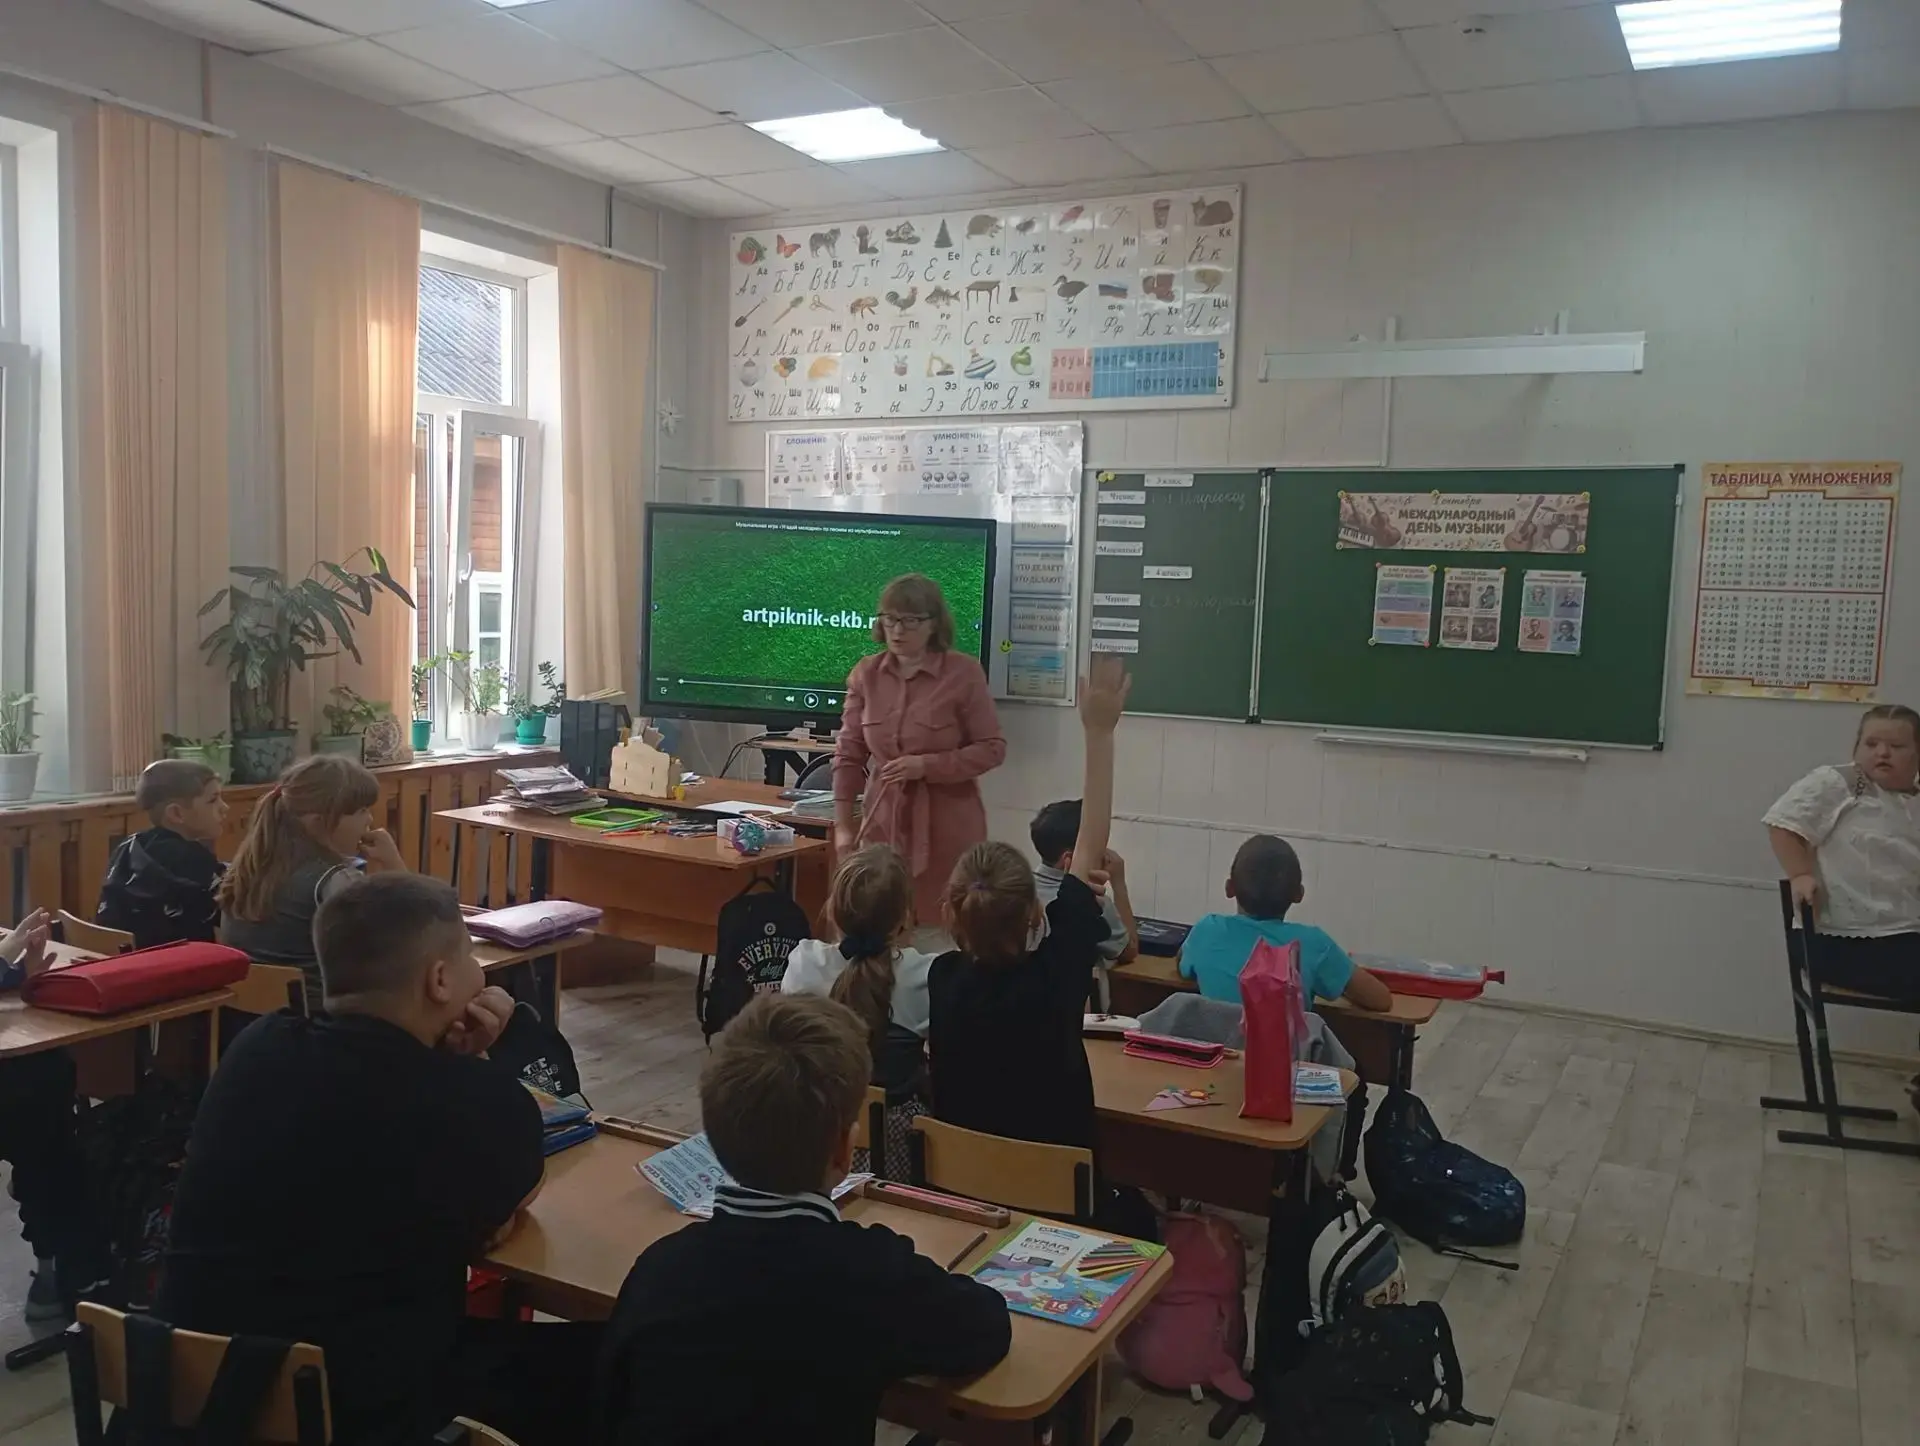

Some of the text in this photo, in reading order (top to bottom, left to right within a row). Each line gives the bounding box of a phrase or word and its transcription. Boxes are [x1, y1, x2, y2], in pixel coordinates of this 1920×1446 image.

[1711, 472, 1892, 487] ТАБЛИЦА УМНОЖЕНИЯ
[1398, 508, 1515, 521] МЕЖДУНАРОДНЫЙ
[1405, 522, 1505, 534] ДЕНЬ МУЗЫКИ
[742, 607, 878, 629] artpiknik-ekb.r
[738, 943, 790, 970] EVERYD
[1051, 1301, 1068, 1312] 16
